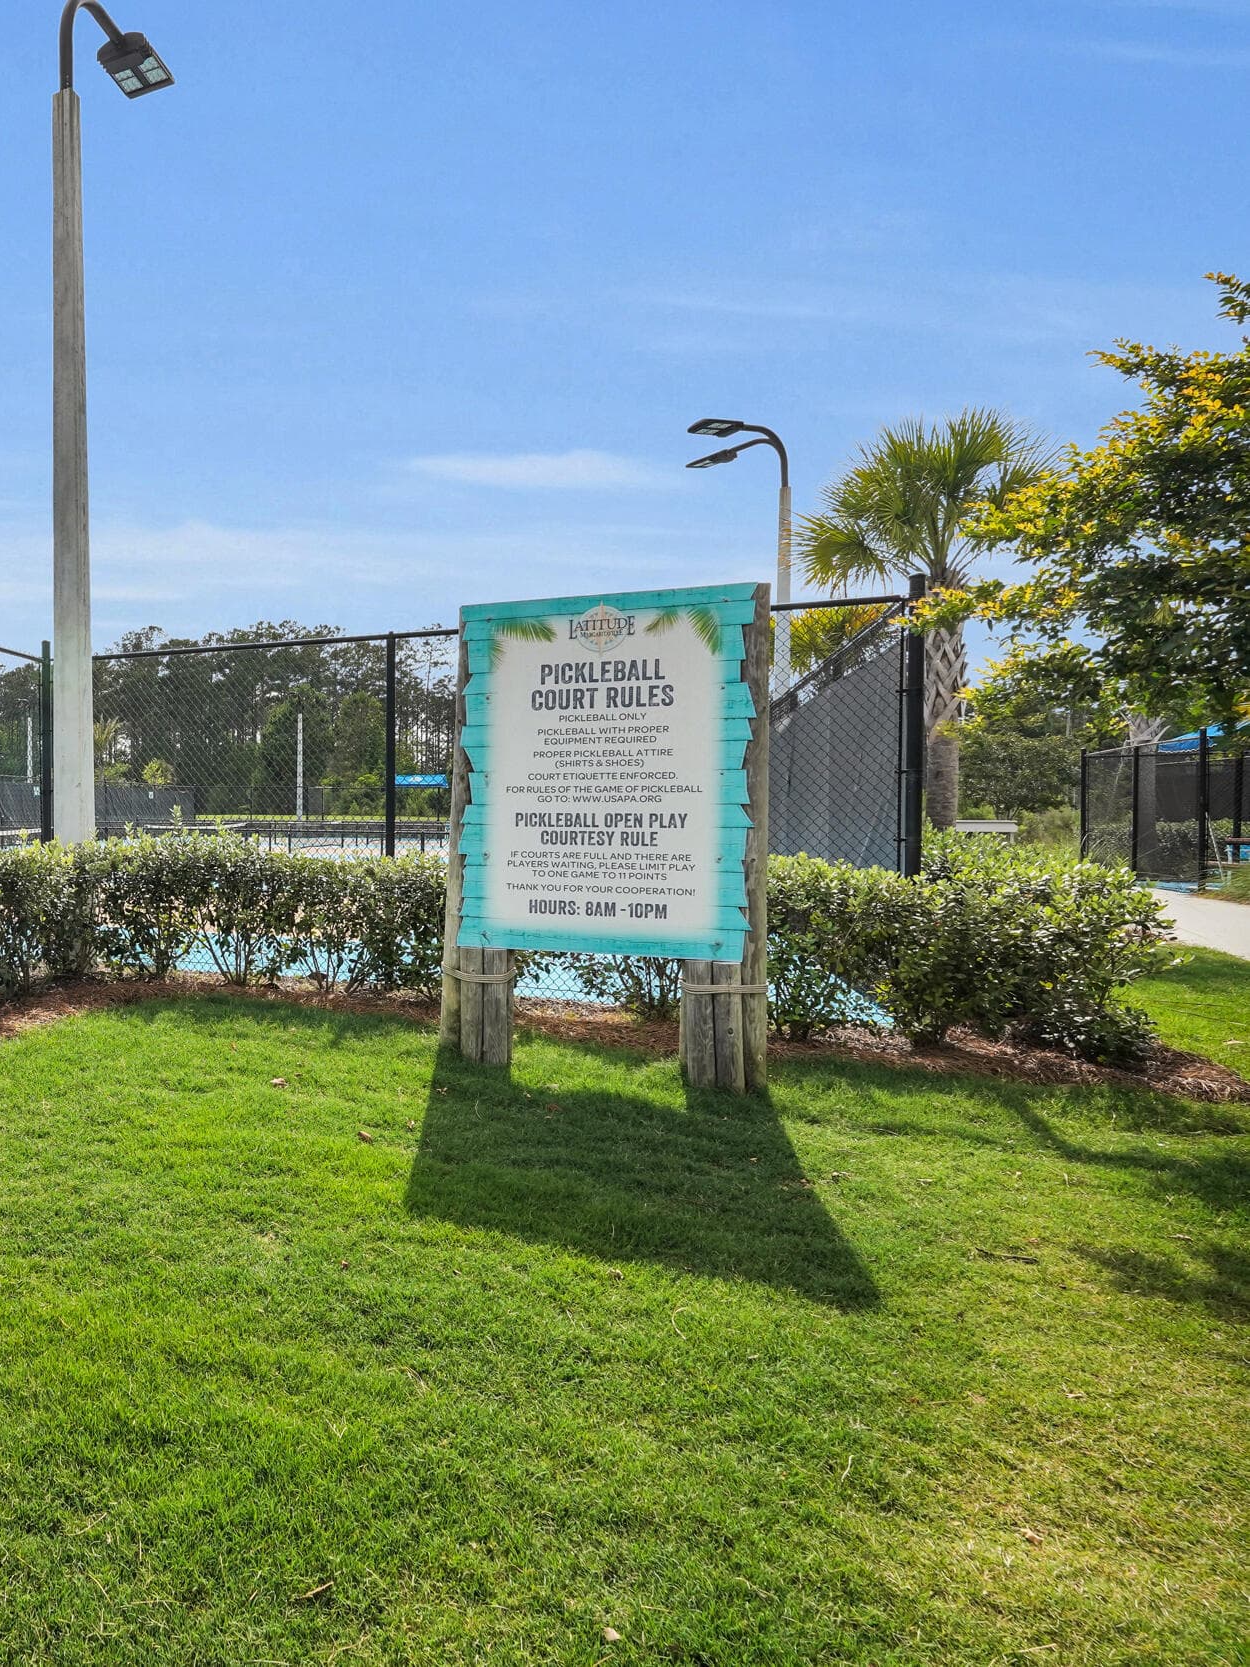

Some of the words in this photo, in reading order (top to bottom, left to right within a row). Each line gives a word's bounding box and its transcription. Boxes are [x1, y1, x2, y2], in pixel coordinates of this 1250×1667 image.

[569, 615, 636, 640] LATITUDE
[540, 658, 666, 685] PICKLEBALL
[532, 688, 598, 711] COURT
[606, 684, 674, 708] RULES
[559, 714, 618, 723] PICKLEBALL
[619, 713, 647, 721] ONLY
[538, 728, 597, 737] PICKLEBALL
[599, 727, 626, 735] WITH
[628, 726, 670, 734] PROPER
[544, 737, 603, 746] EQUIPMENT
[605, 736, 658, 744] REQUIRED
[534, 751, 572, 759] PROPER
[574, 750, 635, 758] PICKLEBALL
[636, 749, 674, 757] ATTIRE
[555, 760, 594, 770] (SHIRTS
[605, 759, 645, 768] SHOES)
[528, 773, 562, 781] COURT
[563, 773, 618, 781] ETIQUETTE
[620, 772, 679, 780] ENFORCED.
[507, 786, 526, 794] FOR
[527, 786, 557, 794] RULES
[558, 786, 572, 794] OF
[573, 786, 593, 794] THE
[595, 786, 624, 794] GAME
[625, 786, 640, 794] OF
[641, 785, 703, 794] PICKLEBALL
[554, 795, 571, 803] TO:
[573, 795, 662, 803] WWW.USAPA.ORG
[516, 813, 599, 827] PICKLEBALL
[604, 813, 643, 828] OPEN
[649, 813, 687, 828] PLAY
[541, 831, 615, 846] COURTESY
[621, 831, 658, 846] RULE
[521, 851, 560, 859] COURTS
[562, 852, 582, 860] ARE
[584, 852, 608, 860] FULL
[610, 853, 632, 861] AND
[635, 854, 669, 862] THERE
[671, 854, 692, 862] ARE
[508, 860, 549, 868] PLAYERS
[551, 862, 597, 870] WAITING,
[599, 862, 638, 871] PLEASE
[669, 864, 696, 872] PLAY
[532, 870, 546, 878] TO
[572, 871, 600, 879] GAME
[602, 872, 617, 880] TO
[629, 873, 668, 881] POINTS
[507, 883, 539, 891] THANK
[541, 884, 562, 892] YOU
[564, 885, 584, 893] FOR
[586, 886, 614, 894] YOUR
[615, 887, 696, 896] COOPERATION!
[529, 900, 580, 915] HOURS:
[586, 901, 616, 917] 8AM
